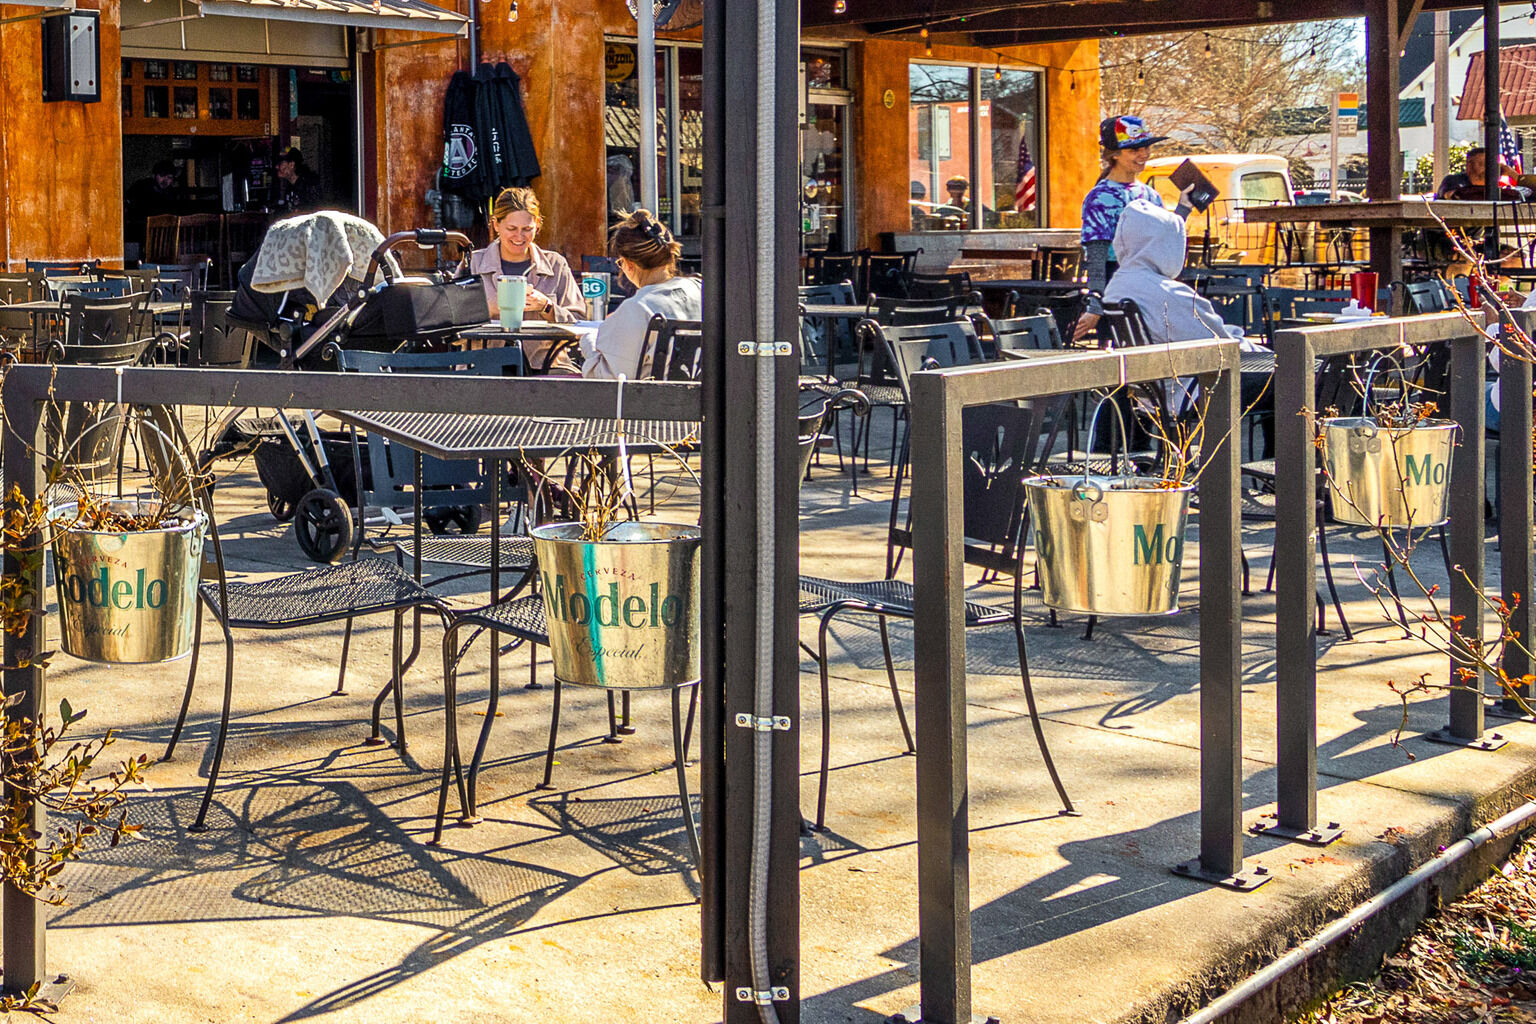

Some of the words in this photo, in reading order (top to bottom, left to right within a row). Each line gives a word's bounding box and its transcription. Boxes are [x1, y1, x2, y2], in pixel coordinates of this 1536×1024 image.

[60, 566, 168, 610] odelo
[580, 567, 636, 581] CERVEZA
[543, 570, 683, 629] Modelo
[576, 636, 645, 662] Especial
